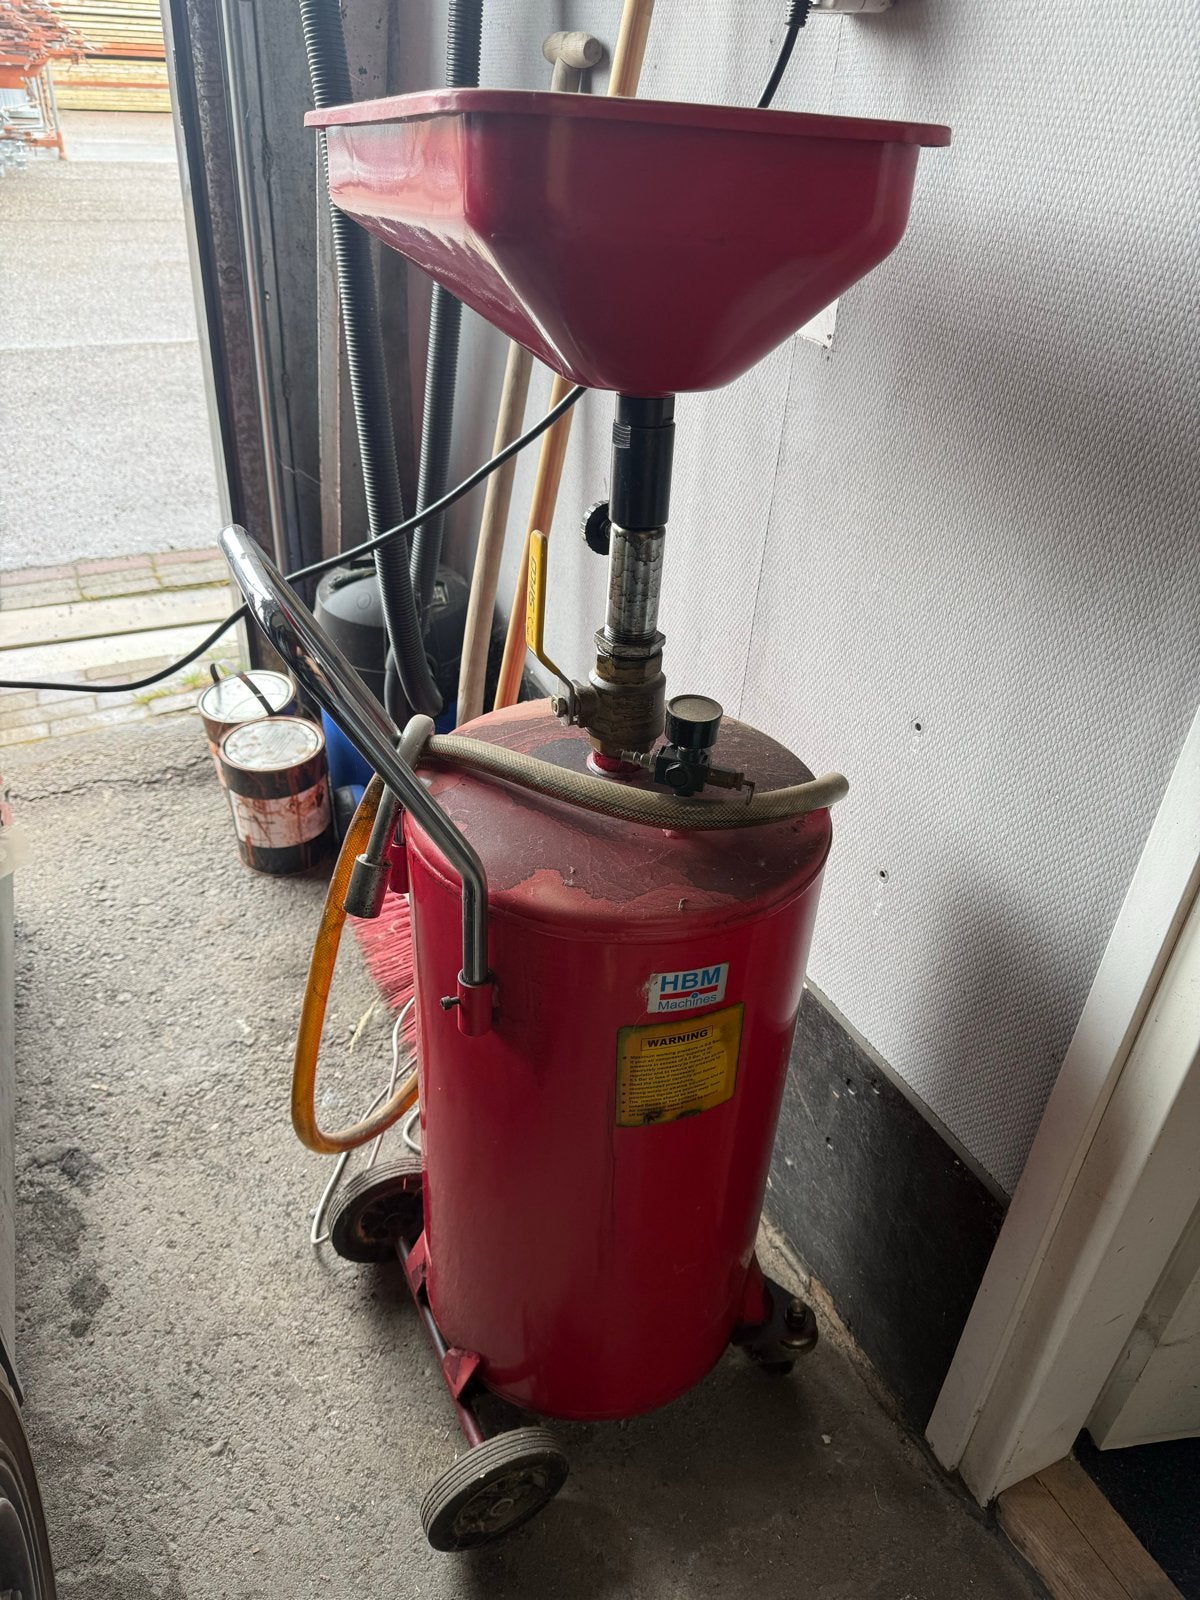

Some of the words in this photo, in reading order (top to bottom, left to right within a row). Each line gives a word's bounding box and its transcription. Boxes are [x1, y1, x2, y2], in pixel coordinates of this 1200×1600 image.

[660, 966, 721, 992] HBM
[657, 994, 717, 1011] Machines
[647, 1029, 708, 1048] WARNING
